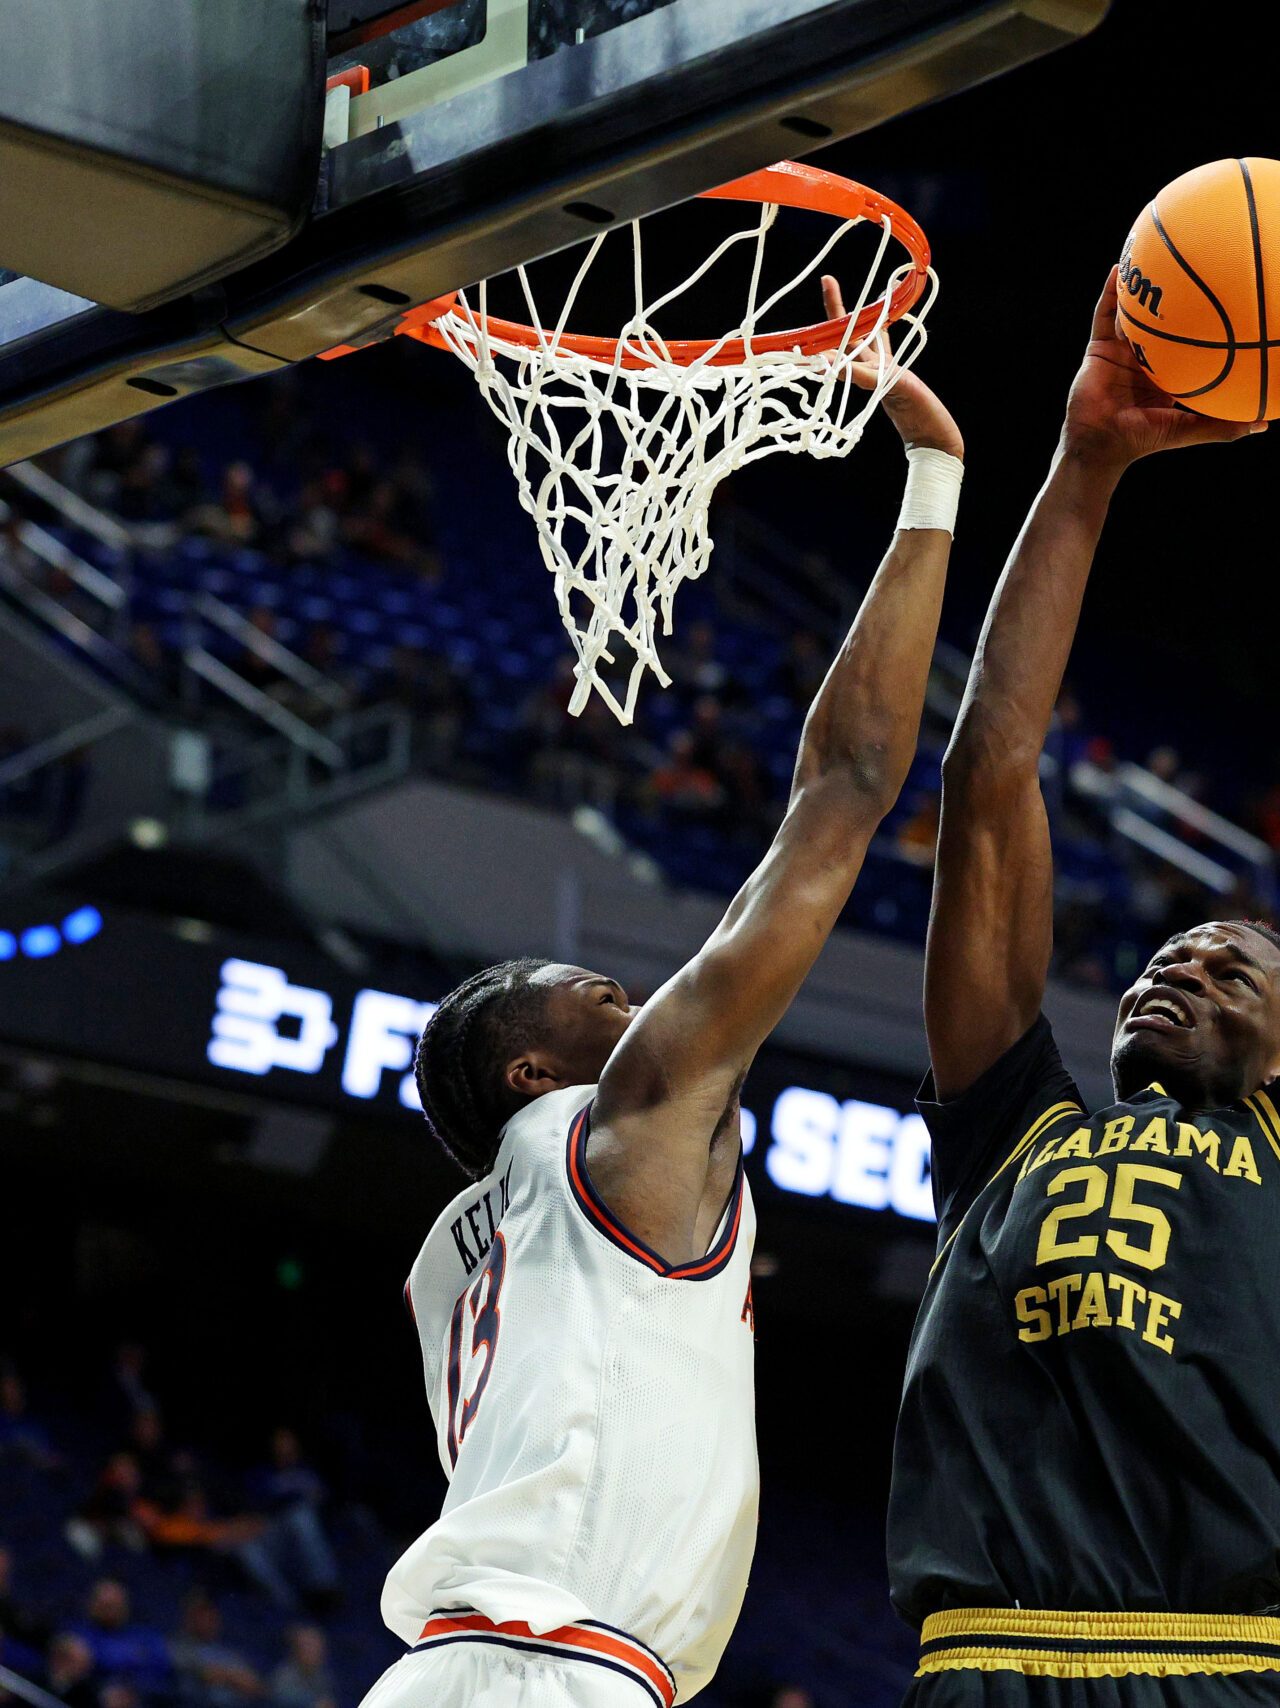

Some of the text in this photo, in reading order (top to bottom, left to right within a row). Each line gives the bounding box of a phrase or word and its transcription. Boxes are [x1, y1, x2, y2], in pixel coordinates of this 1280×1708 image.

[1035, 1163, 1182, 1271] 25
[447, 1231, 506, 1472] 13
[1014, 1272, 1183, 1355] STATE
